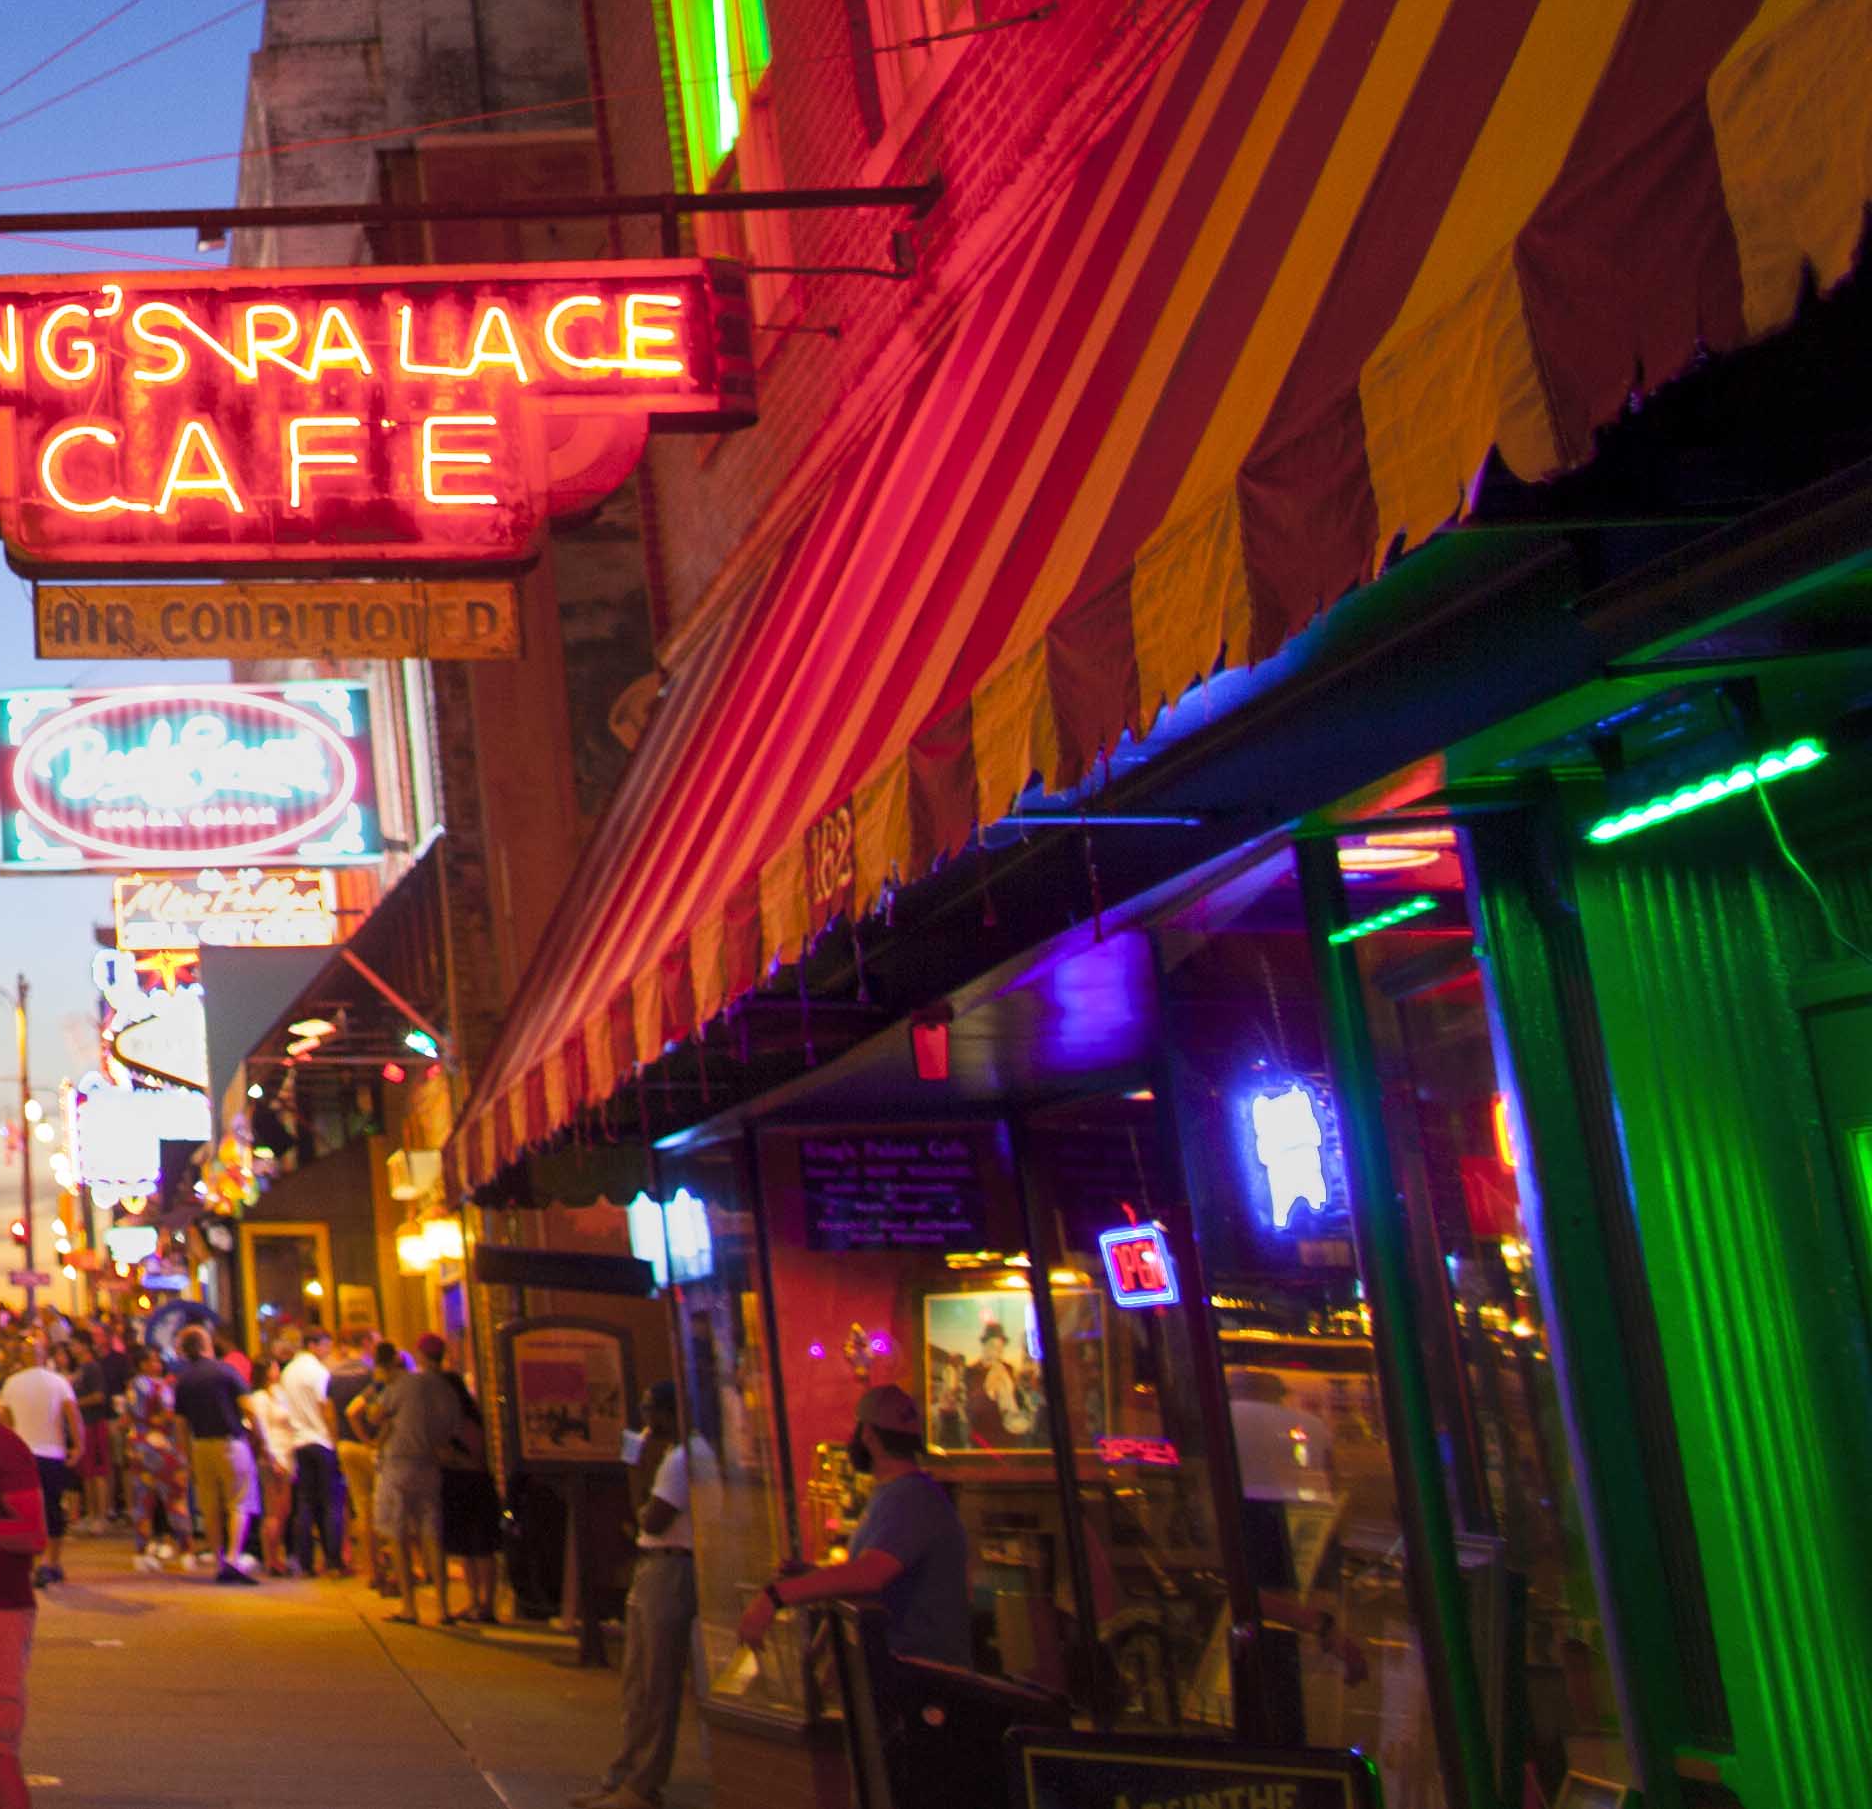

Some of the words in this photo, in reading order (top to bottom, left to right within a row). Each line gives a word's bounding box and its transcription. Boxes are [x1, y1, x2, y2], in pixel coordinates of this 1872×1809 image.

[246, 294, 686, 384] PALACE
[39, 414, 499, 514] CAFE
[55, 601, 134, 644] AIR
[1113, 1783, 1297, 1809] INTHE
